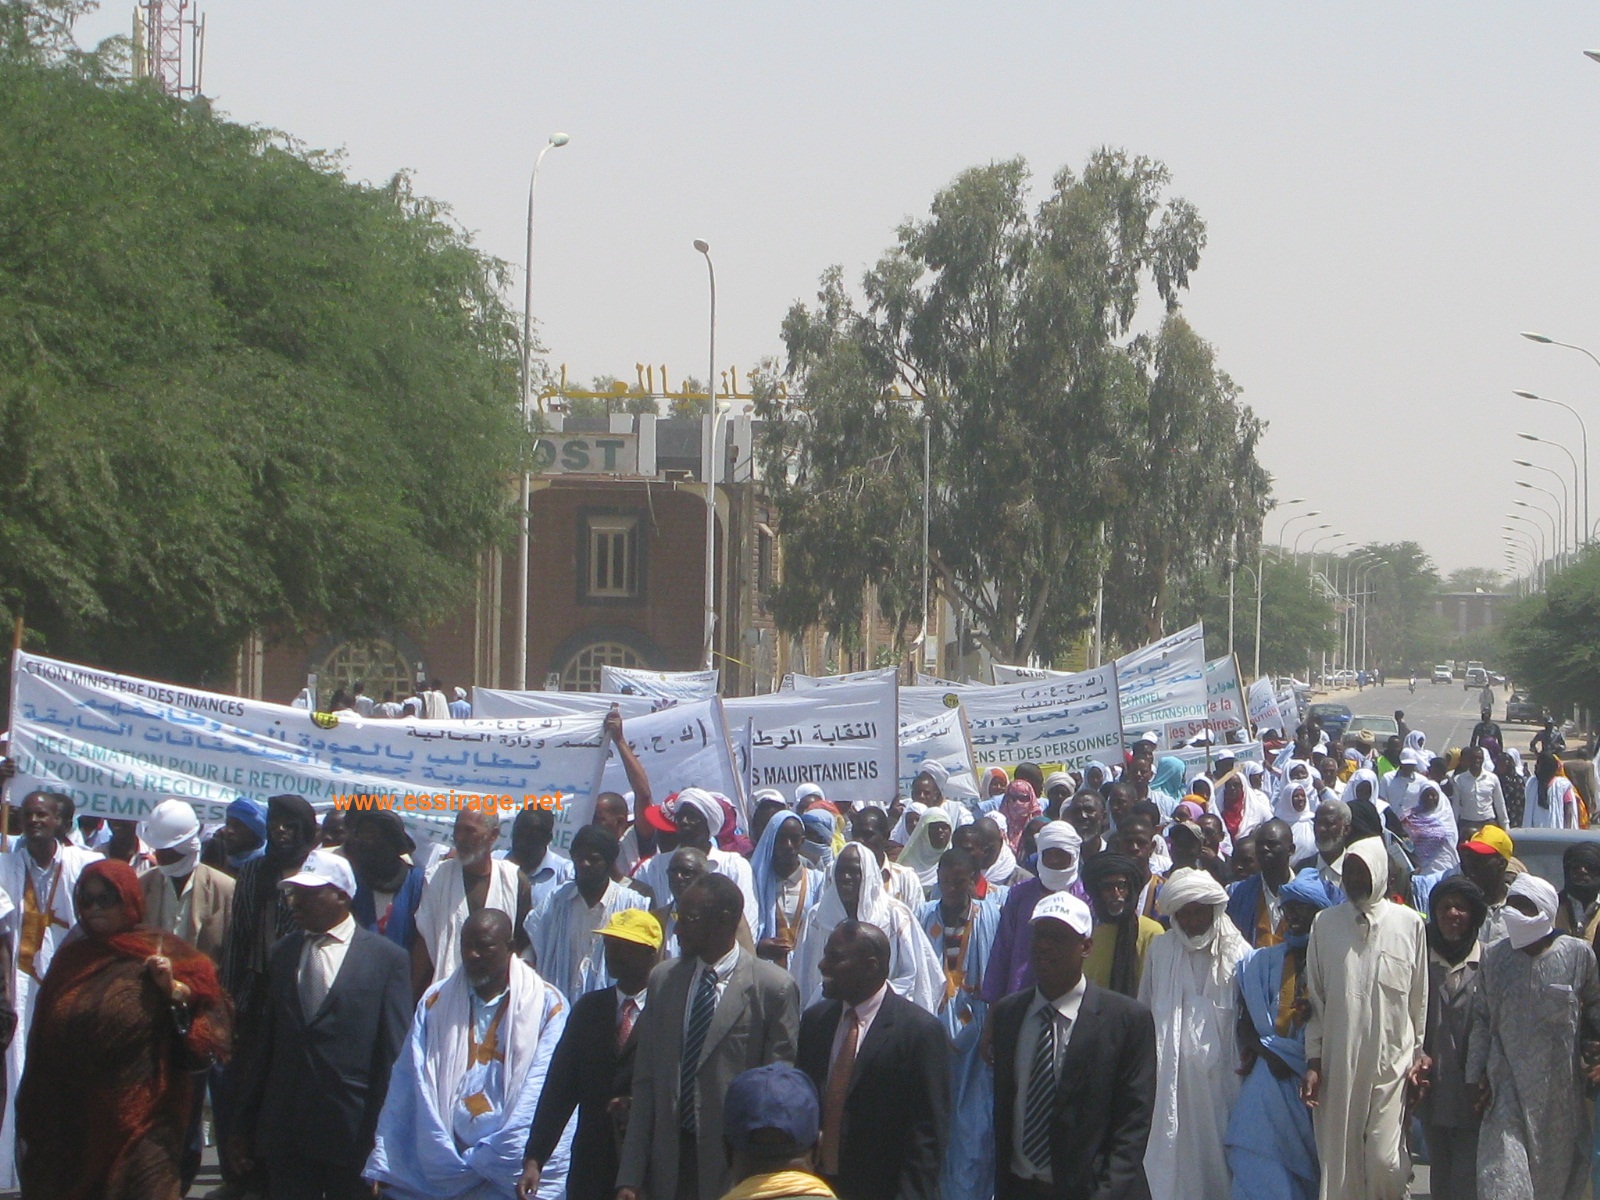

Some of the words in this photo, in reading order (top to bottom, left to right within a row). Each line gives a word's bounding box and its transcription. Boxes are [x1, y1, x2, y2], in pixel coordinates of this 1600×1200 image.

[71, 672, 144, 697] MINISTERE
[148, 686, 174, 704] DES
[178, 692, 244, 716] FINANCES
[1220, 698, 1232, 712] la
[1150, 704, 1207, 720] TRANSPORT
[812, 722, 877, 747] النقابة
[1000, 749, 1013, 763] ET
[1018, 746, 1042, 761] DES
[1045, 732, 1120, 757] PERSONNES
[44, 760, 103, 785] POUR
[110, 767, 137, 789] LA
[168, 756, 217, 781] POUR
[224, 768, 244, 785] LE
[250, 770, 321, 797] RETOUR
[764, 760, 879, 786] MAURITANIENS
[1042, 905, 1070, 915] CLTM
